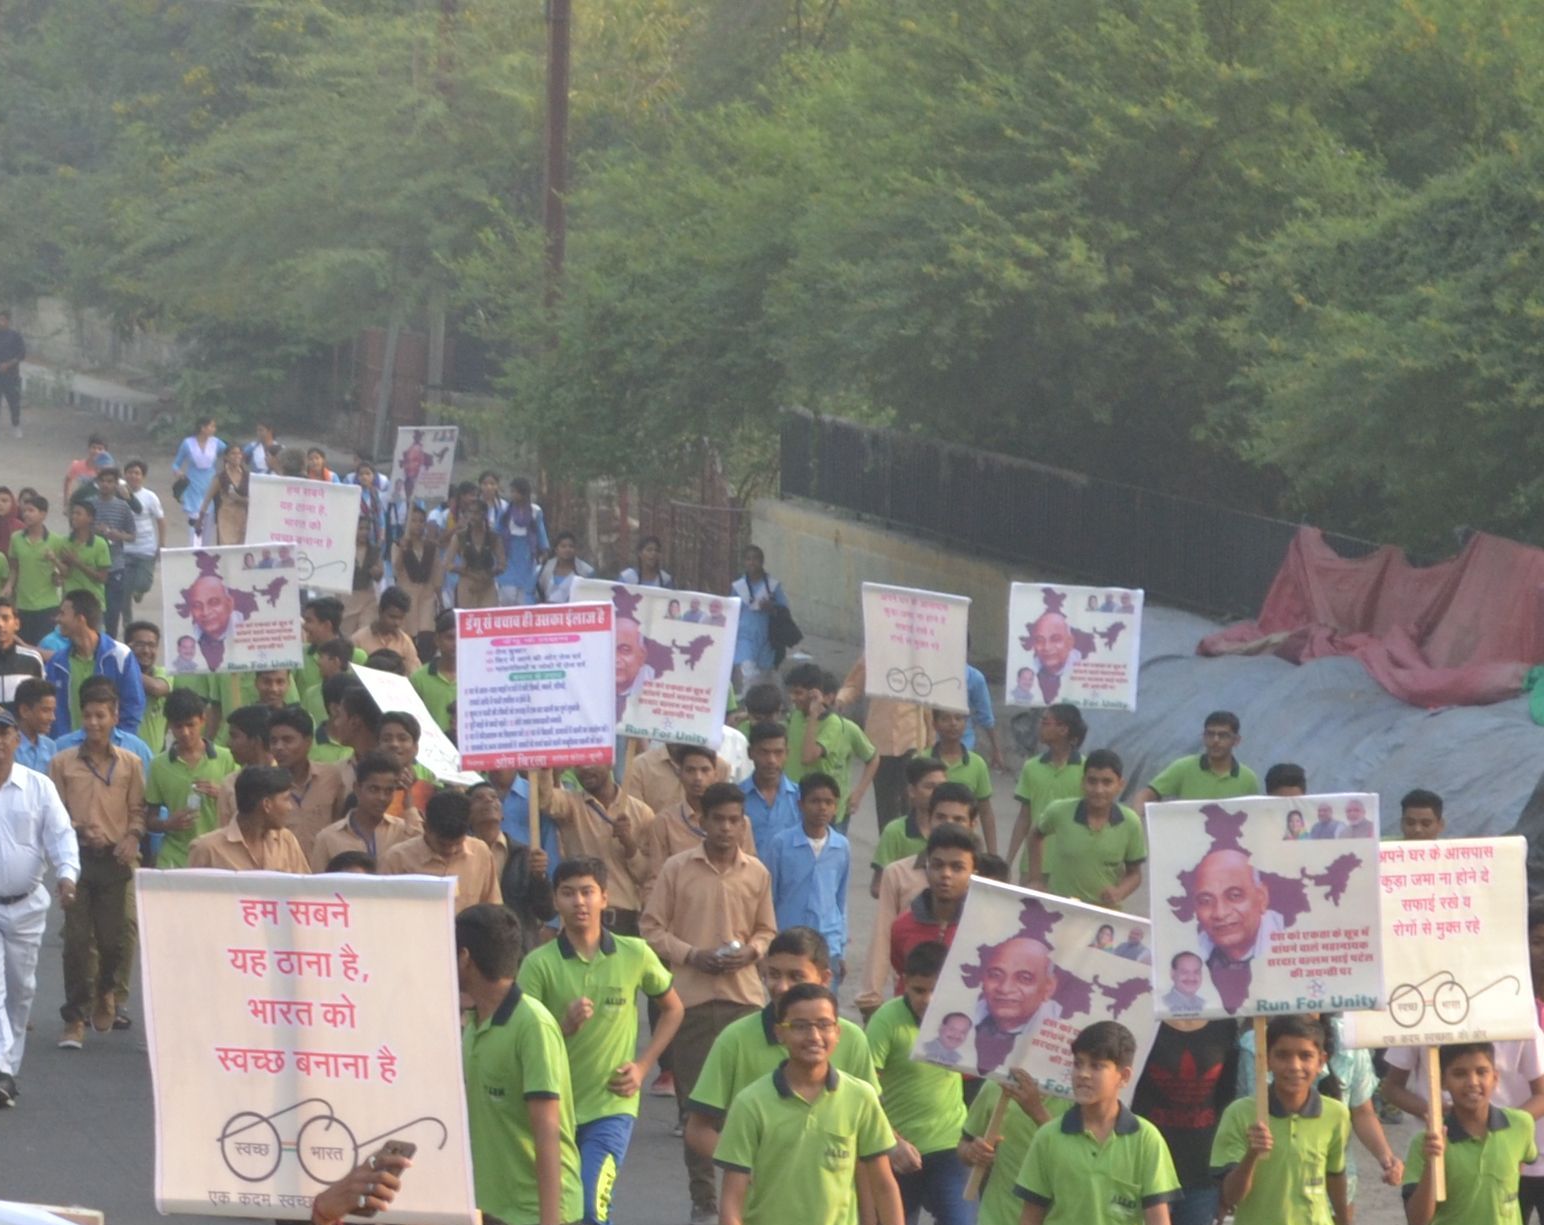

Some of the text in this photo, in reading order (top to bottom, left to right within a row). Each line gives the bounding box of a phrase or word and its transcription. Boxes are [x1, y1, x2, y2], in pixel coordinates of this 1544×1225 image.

[1429, 843, 1441, 860] के
[1445, 845, 1494, 860] आसपास
[1411, 872, 1435, 886] जमा
[1438, 872, 1452, 885] ना
[1455, 867, 1477, 886] होने
[240, 892, 350, 928] हम सबने
[1422, 917, 1433, 935] से
[227, 943, 369, 983] यह ठाना है,
[248, 993, 356, 1029] भारत को
[1257, 994, 1378, 1012] Run For Unity
[215, 1045, 397, 1084] स्वच्छ बनाना है
[234, 1142, 271, 1157] स्वच्छ
[310, 1146, 344, 1161] भारत
[208, 1190, 231, 1208] एक
[237, 1191, 272, 1208] कदम
